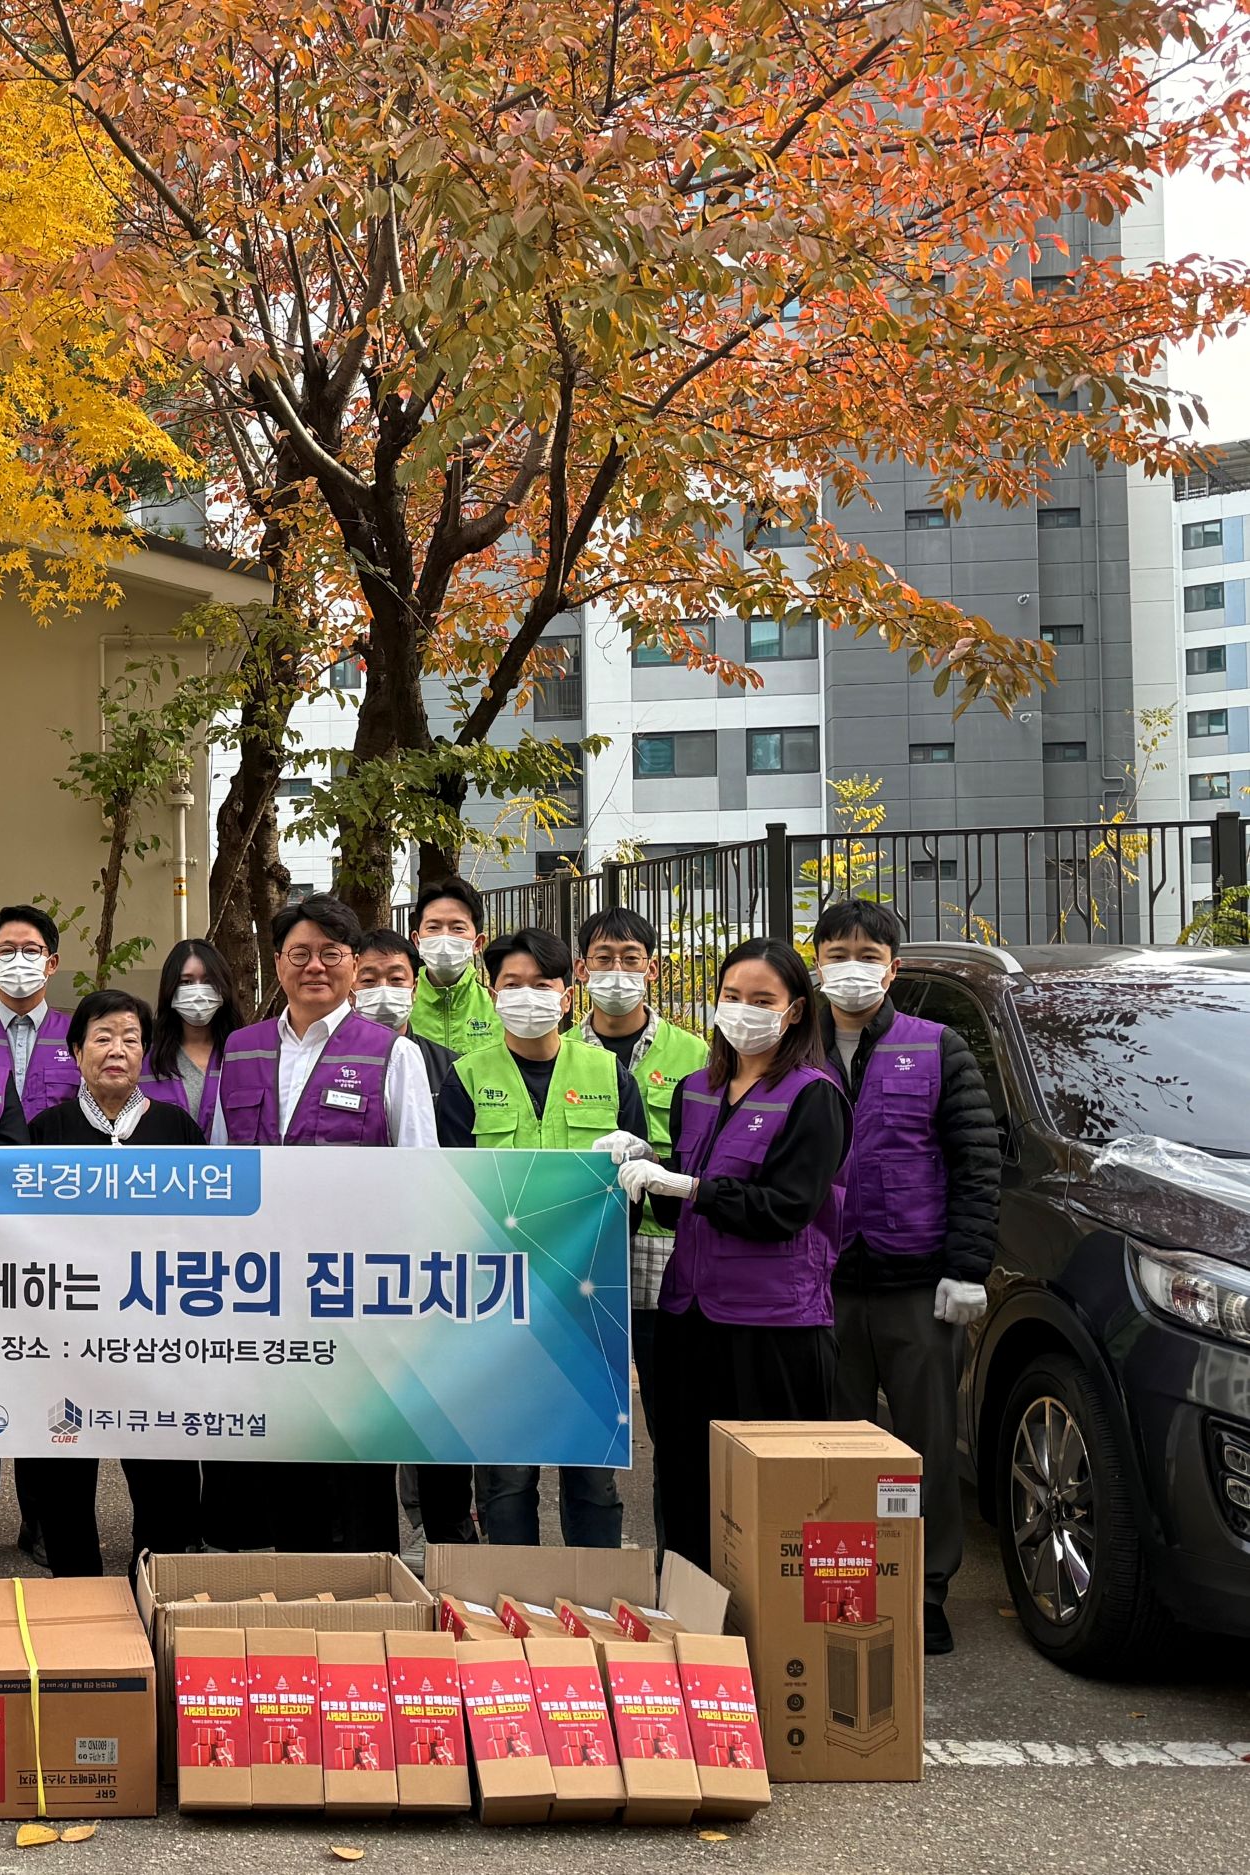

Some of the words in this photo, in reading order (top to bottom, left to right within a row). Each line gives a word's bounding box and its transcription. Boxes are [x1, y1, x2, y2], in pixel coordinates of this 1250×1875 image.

[484, 1089, 503, 1099] 캠코
[11, 1161, 235, 1201] 환경개선사업
[118, 1249, 281, 1318] 사랑의
[305, 1251, 529, 1321] 집고치기
[1, 1336, 51, 1361] 장소
[80, 1337, 336, 1365] 사당삼성아파트경로당
[51, 1435, 79, 1444] CUBE
[780, 1543, 803, 1557] 5W
[780, 1563, 804, 1577] ELE
[875, 1563, 899, 1577] OVE
[69, 1773, 116, 1785] 나비엔매직
[95, 1789, 116, 1798] GRF
